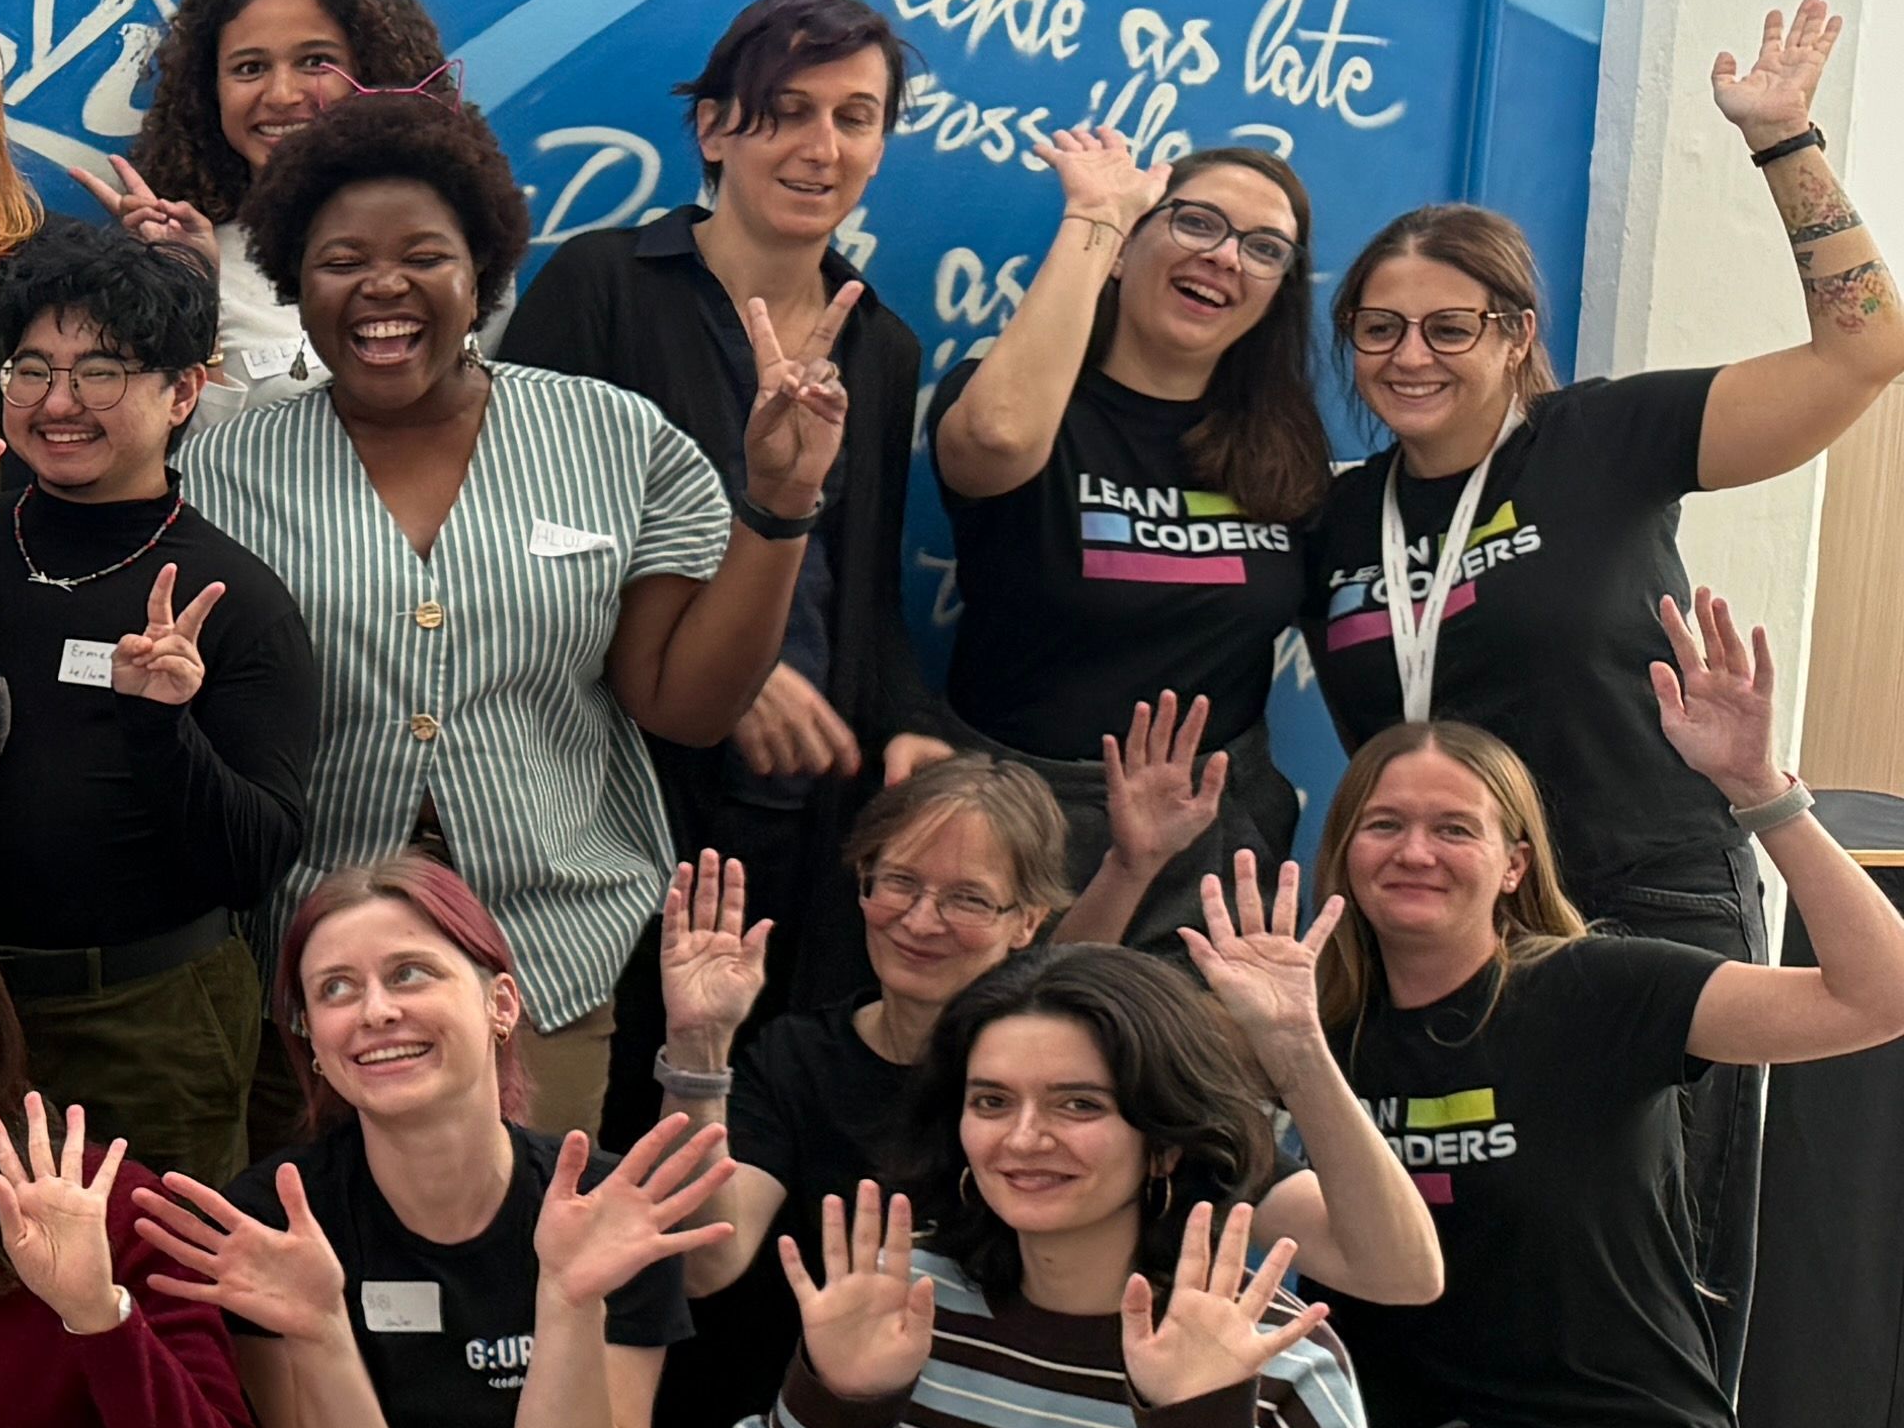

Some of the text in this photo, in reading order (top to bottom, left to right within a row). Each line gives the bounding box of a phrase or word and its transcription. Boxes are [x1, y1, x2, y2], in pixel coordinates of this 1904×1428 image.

[1119, 6, 1221, 85] as
[1078, 473, 1179, 519] LEAN
[1134, 519, 1291, 553] CODERS
[1329, 535, 1430, 589] LEN
[1386, 1123, 1518, 1166] DERS
